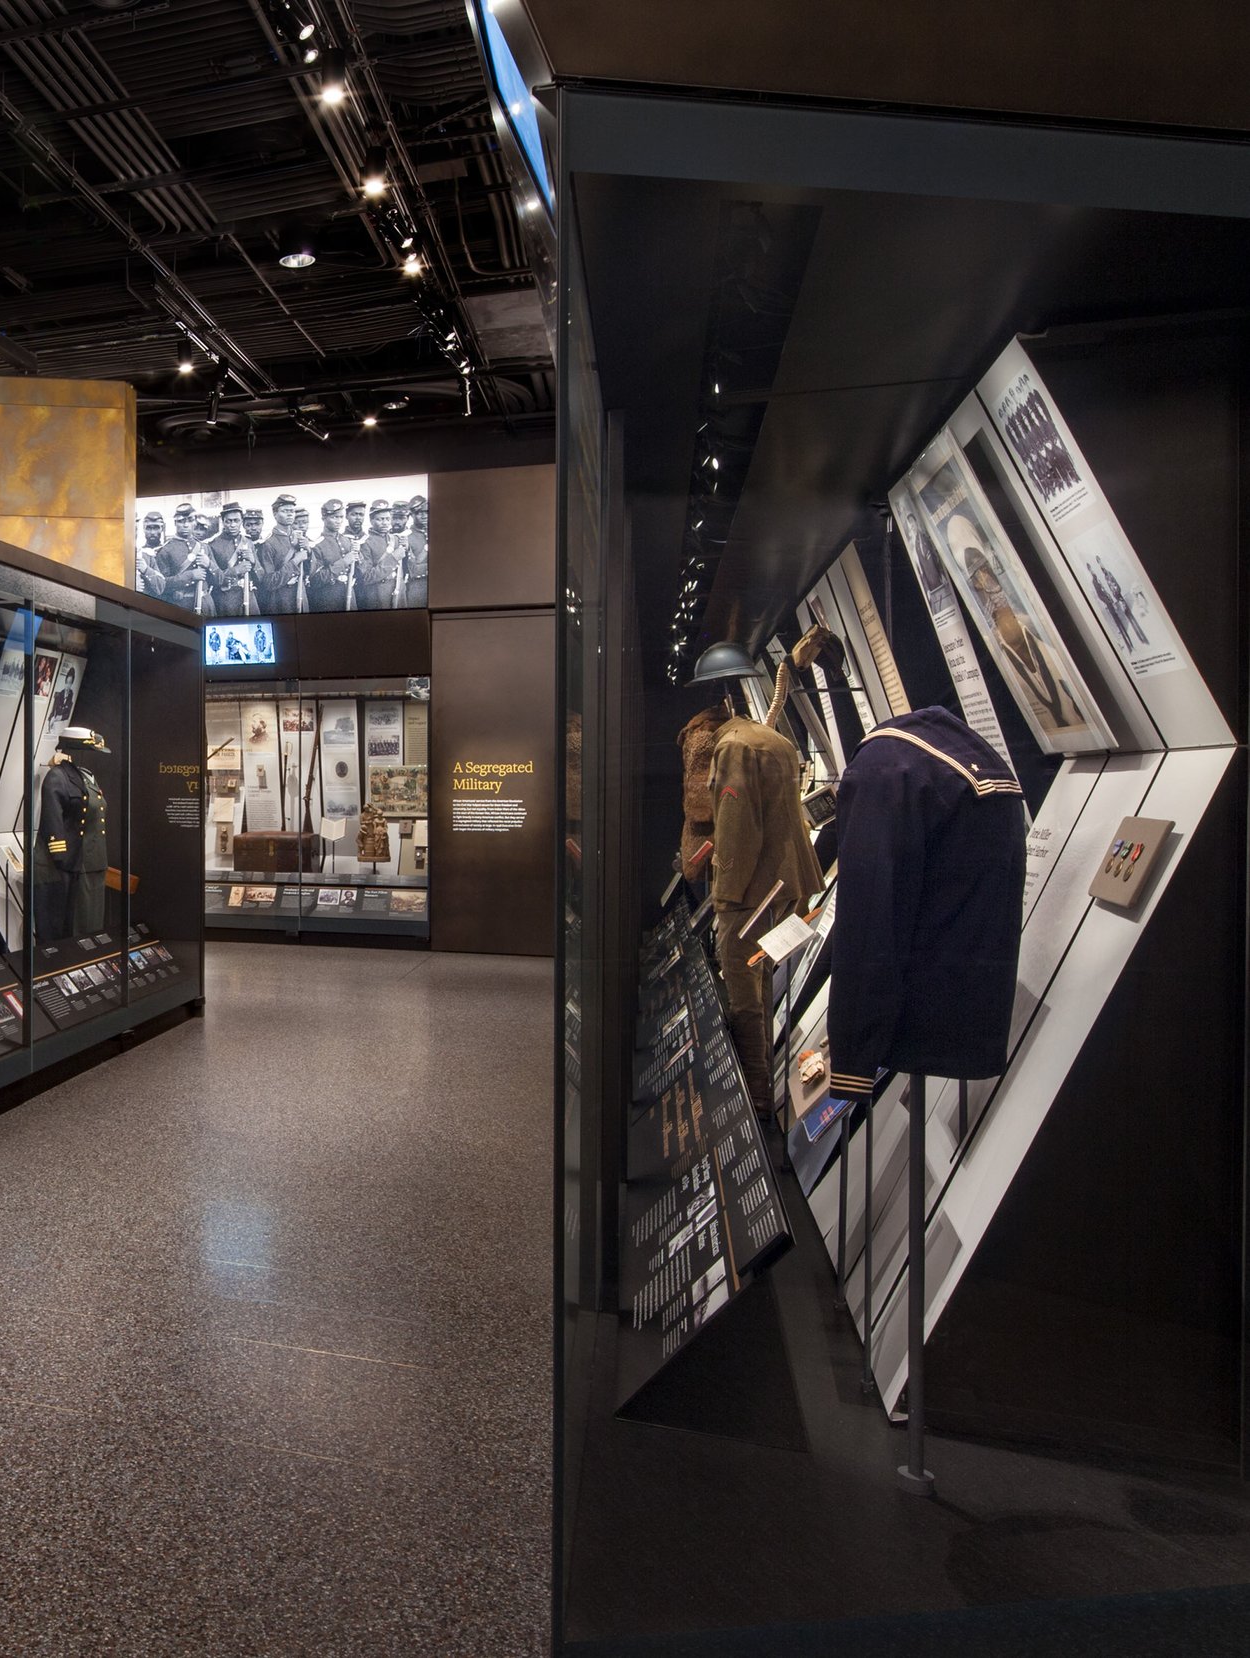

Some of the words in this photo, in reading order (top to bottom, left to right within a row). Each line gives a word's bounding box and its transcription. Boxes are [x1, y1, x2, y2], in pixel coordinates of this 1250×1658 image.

[453, 762, 463, 773] A
[465, 760, 534, 777] Segregated
[453, 779, 502, 793] Military
